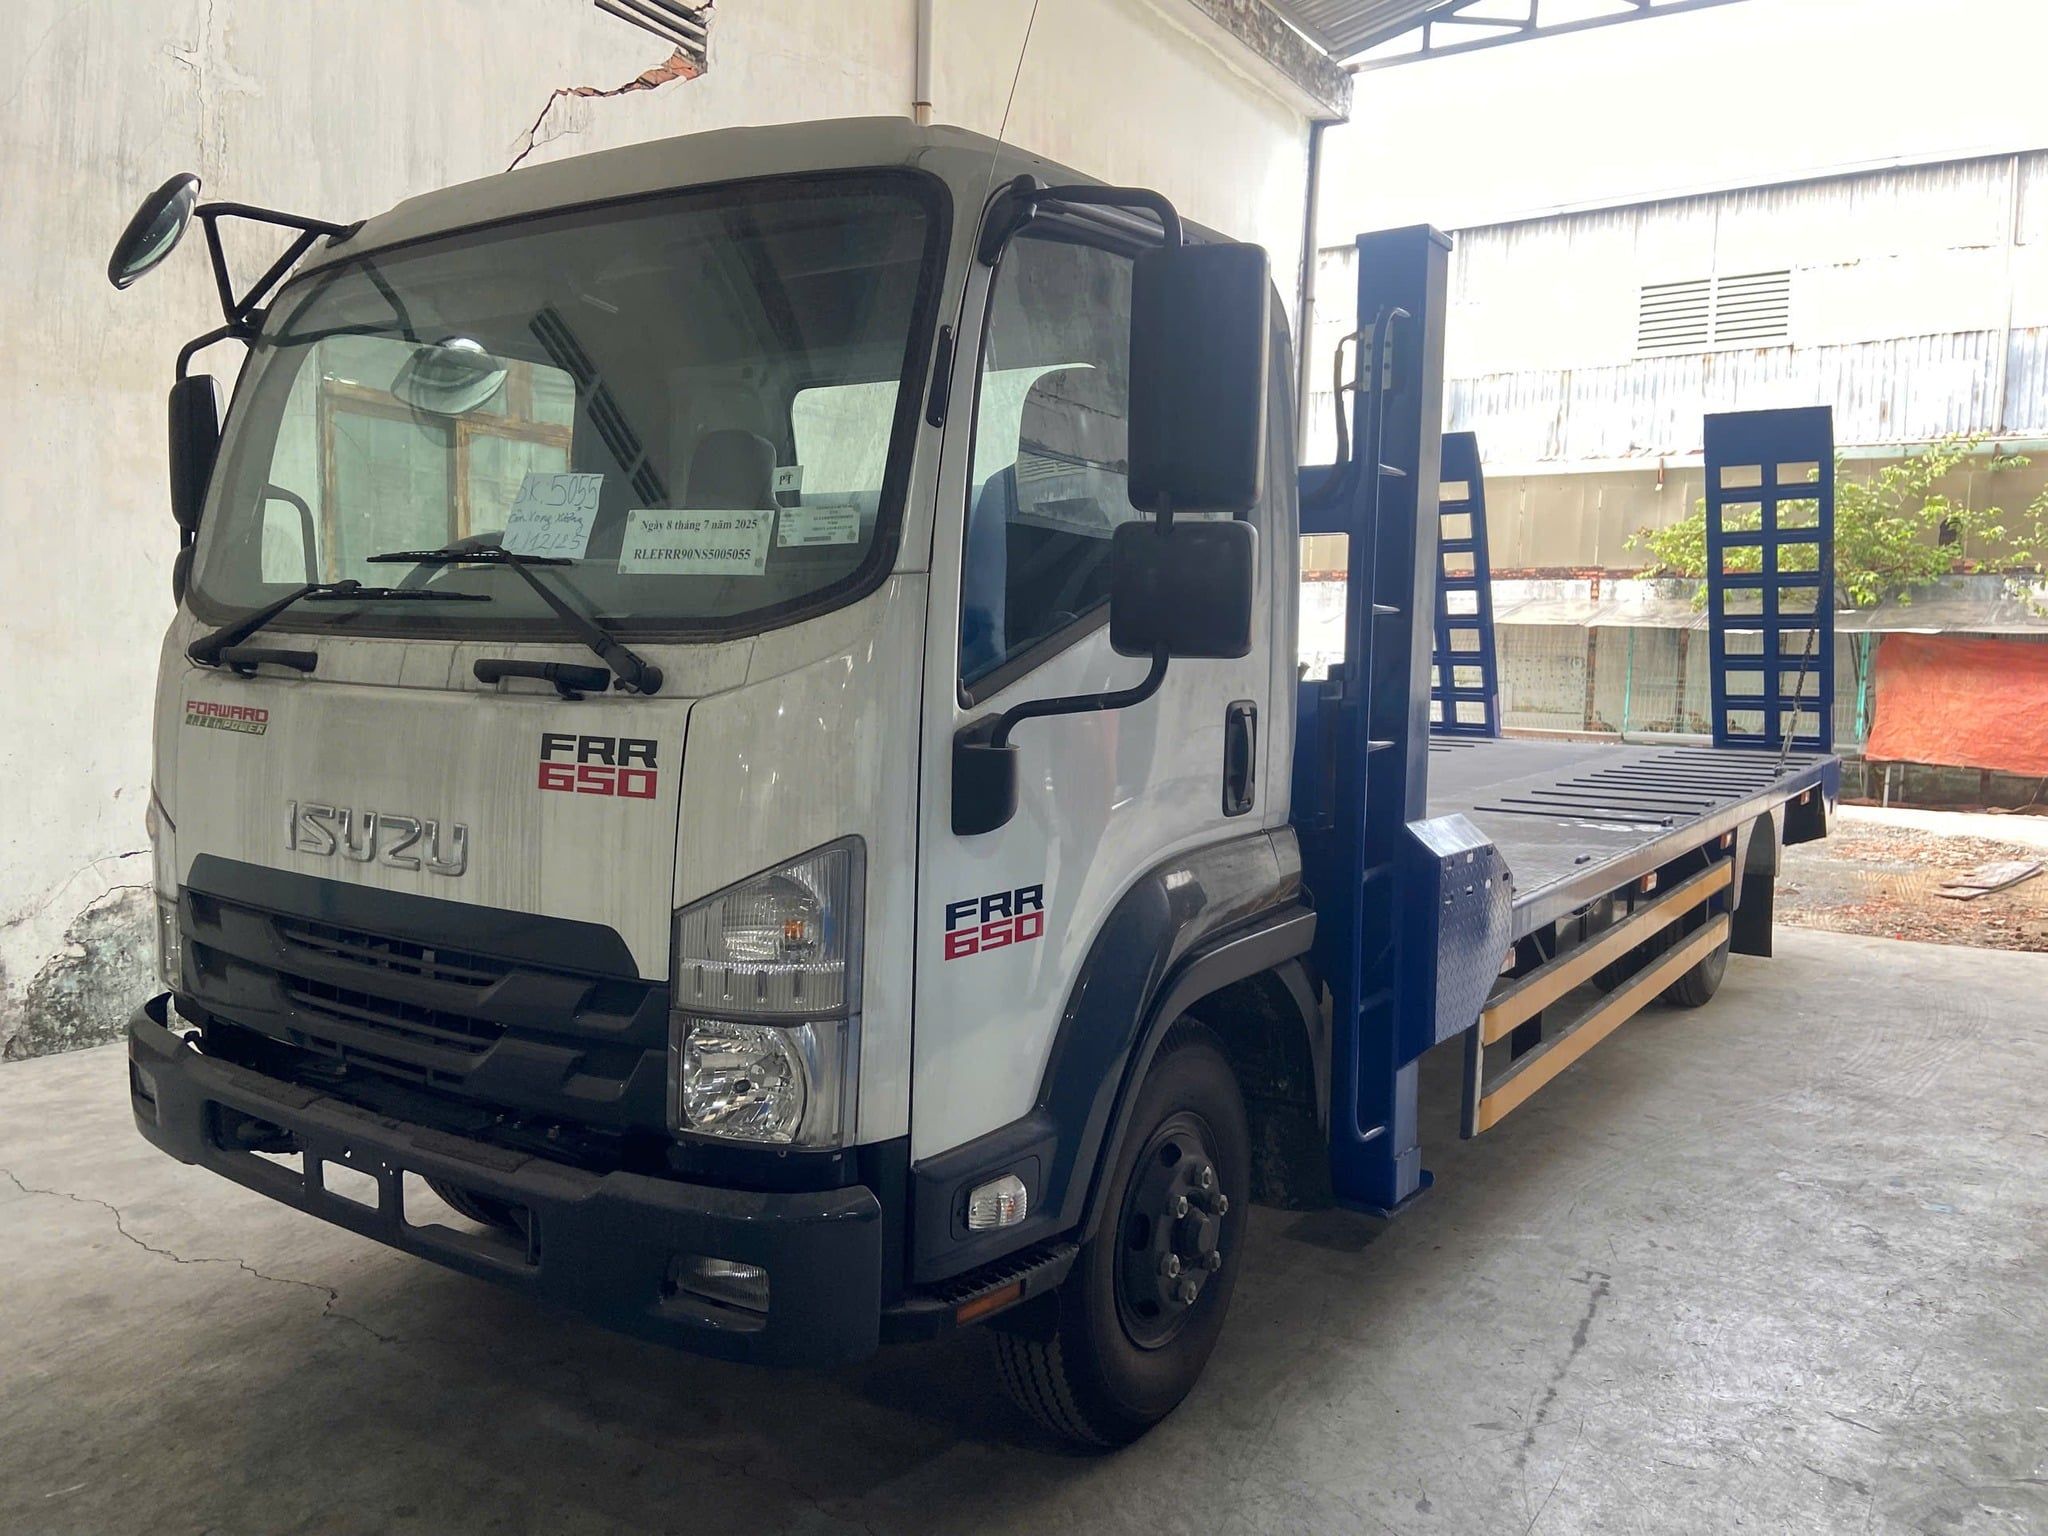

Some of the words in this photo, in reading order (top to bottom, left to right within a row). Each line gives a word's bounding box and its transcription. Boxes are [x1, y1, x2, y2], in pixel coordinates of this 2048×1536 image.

[641, 519, 665, 532] Ngày
[666, 520, 673, 530] 8
[674, 518, 701, 532] tháng
[703, 519, 710, 530] 7
[711, 519, 733, 530] năm
[734, 518, 758, 530] 2025
[633, 548, 751, 561] RLEFRR90NS5005055
[186, 700, 269, 723] FORWARD
[540, 733, 658, 769] FRR
[538, 762, 657, 799] 650
[286, 800, 468, 877] ISUZU
[946, 884, 1044, 932] FRR
[945, 910, 1044, 961] 650
